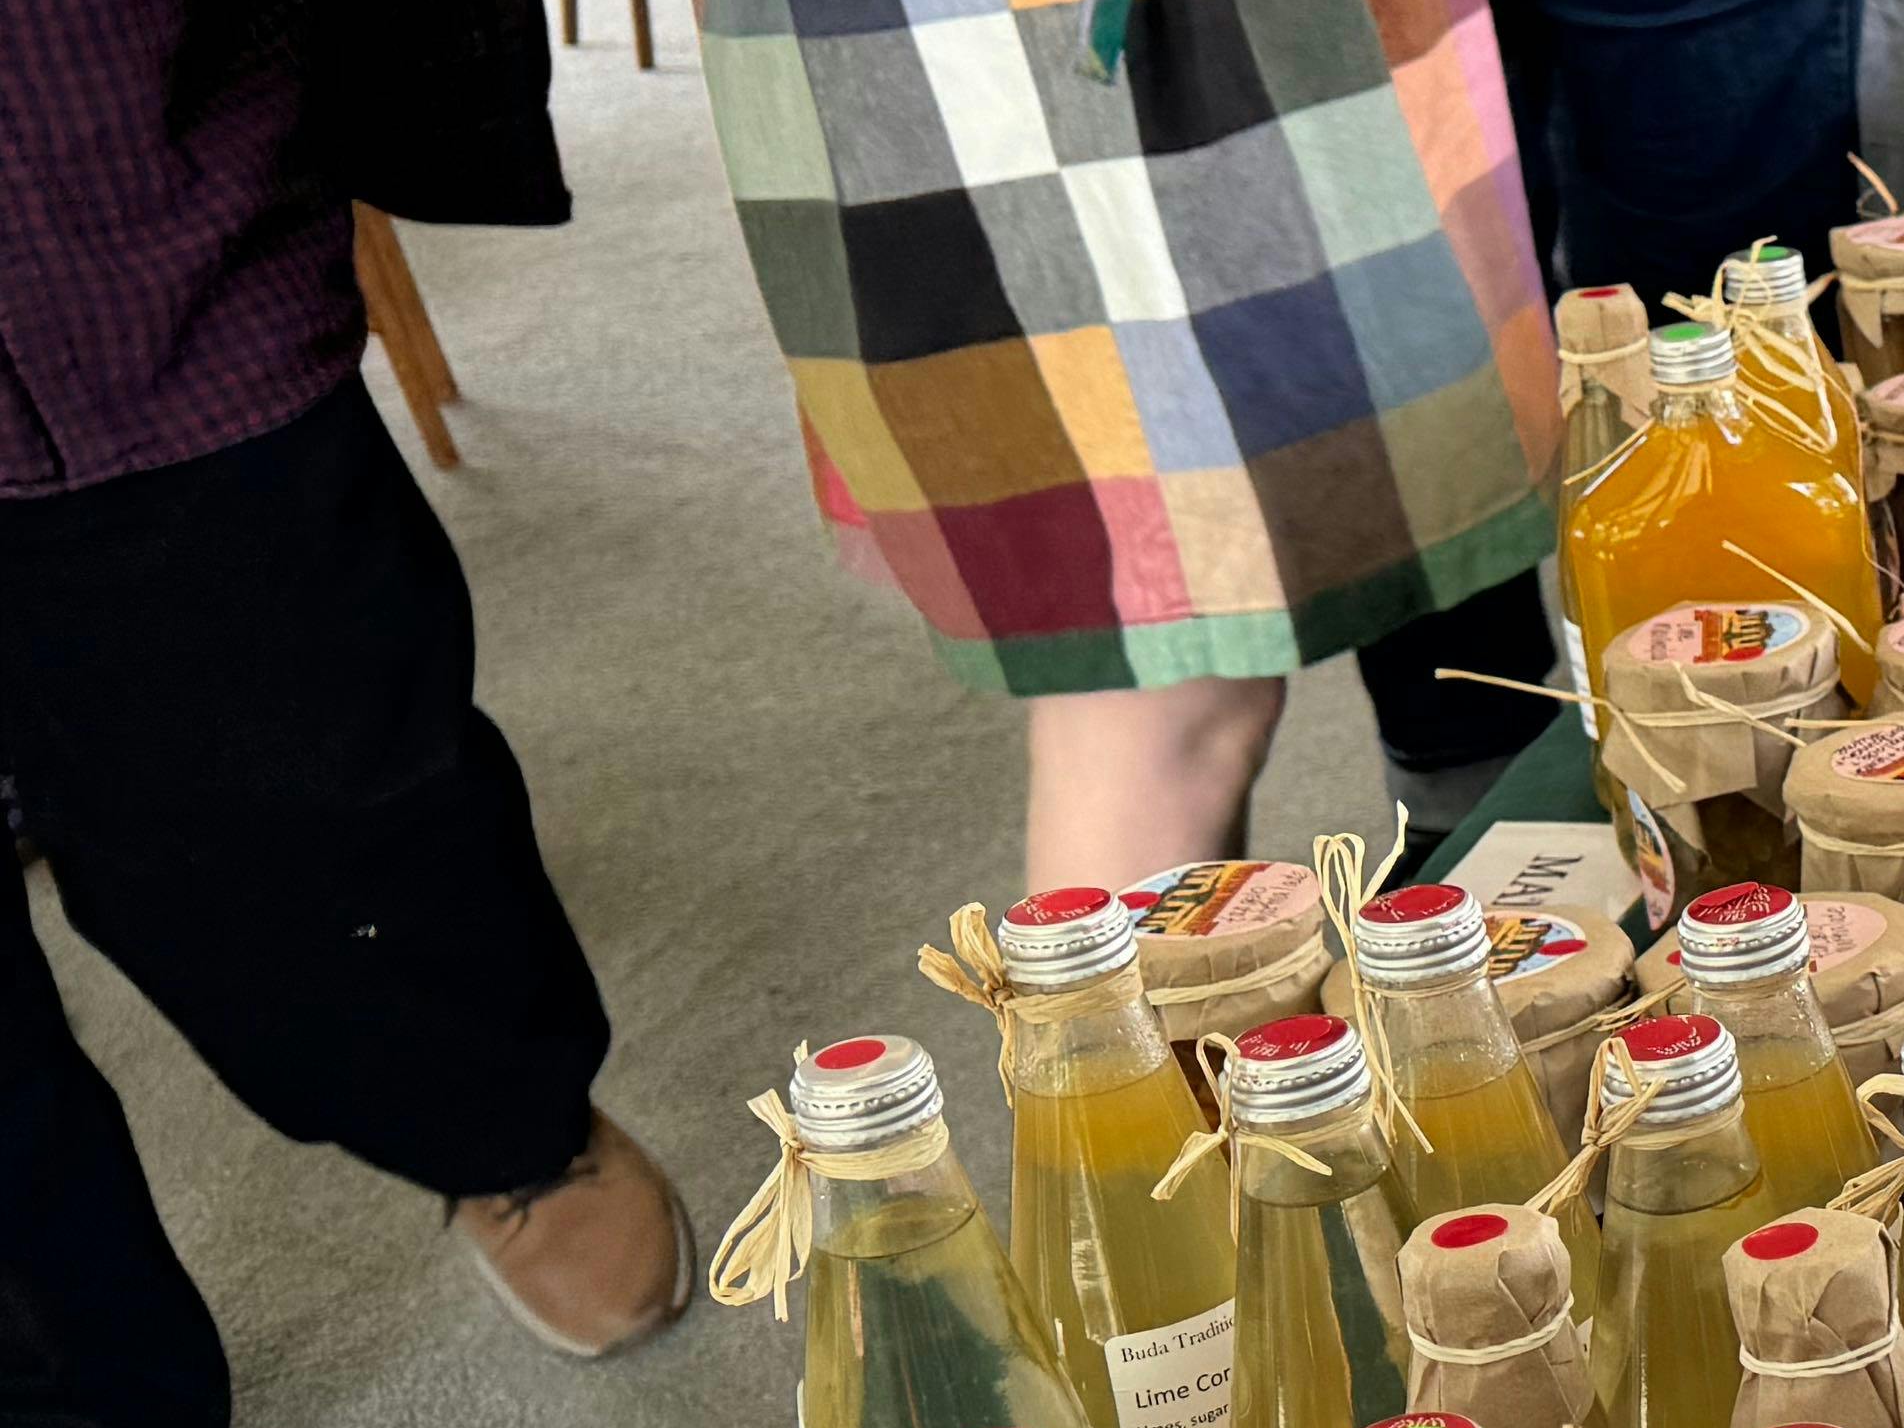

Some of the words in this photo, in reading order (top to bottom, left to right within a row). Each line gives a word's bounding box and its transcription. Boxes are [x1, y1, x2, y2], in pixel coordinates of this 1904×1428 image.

[1121, 1341, 1170, 1364] Buda
[1135, 1384, 1190, 1410] Lime
[1196, 1367, 1232, 1392] Cor
